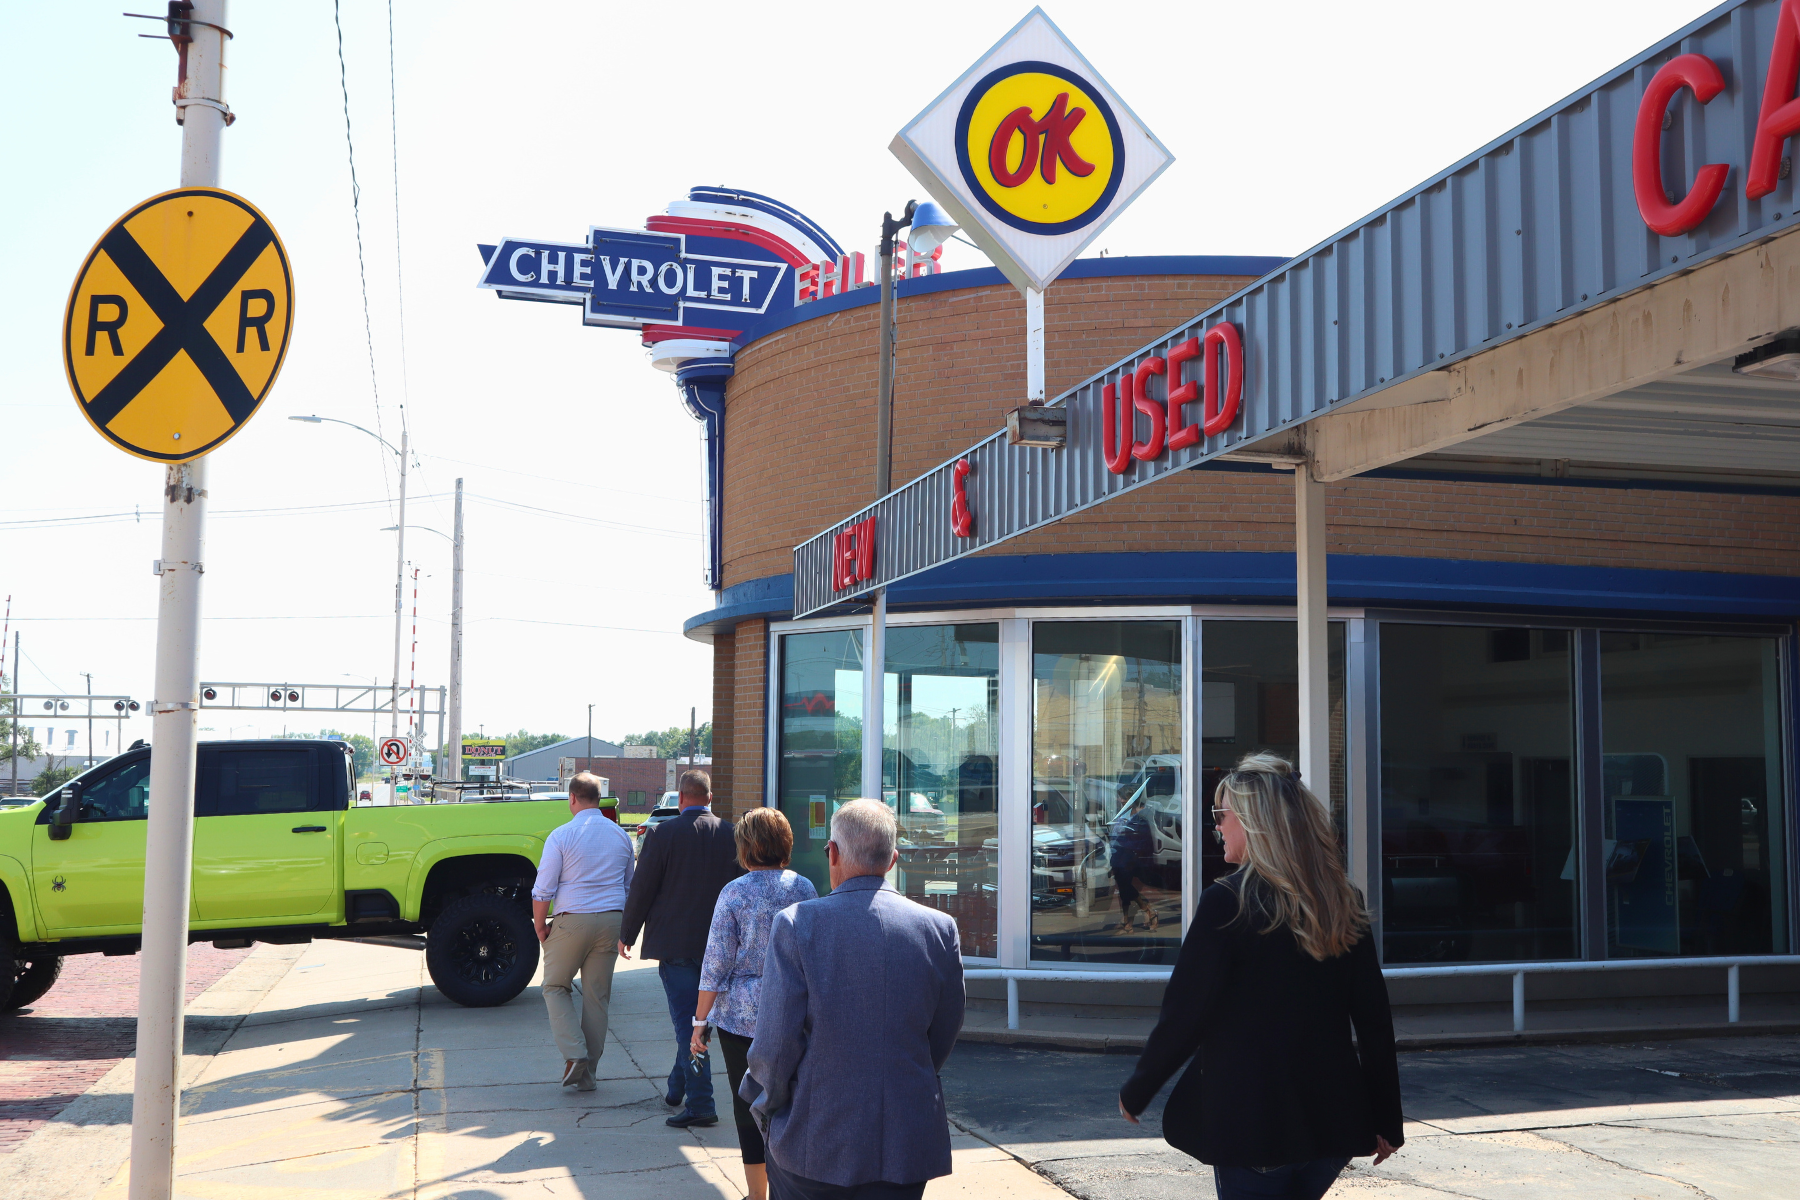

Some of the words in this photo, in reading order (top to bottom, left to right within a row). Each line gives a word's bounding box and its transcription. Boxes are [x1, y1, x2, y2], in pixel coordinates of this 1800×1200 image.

[988, 91, 1096, 188] OK
[508, 246, 759, 303] CHEVROLET
[84, 294, 129, 357] R
[235, 288, 276, 354] R
[832, 515, 876, 592] NEW
[1102, 321, 1244, 475] USED
[465, 746, 503, 754] DONUT
[1662, 805, 1674, 906] CHEVROLET
